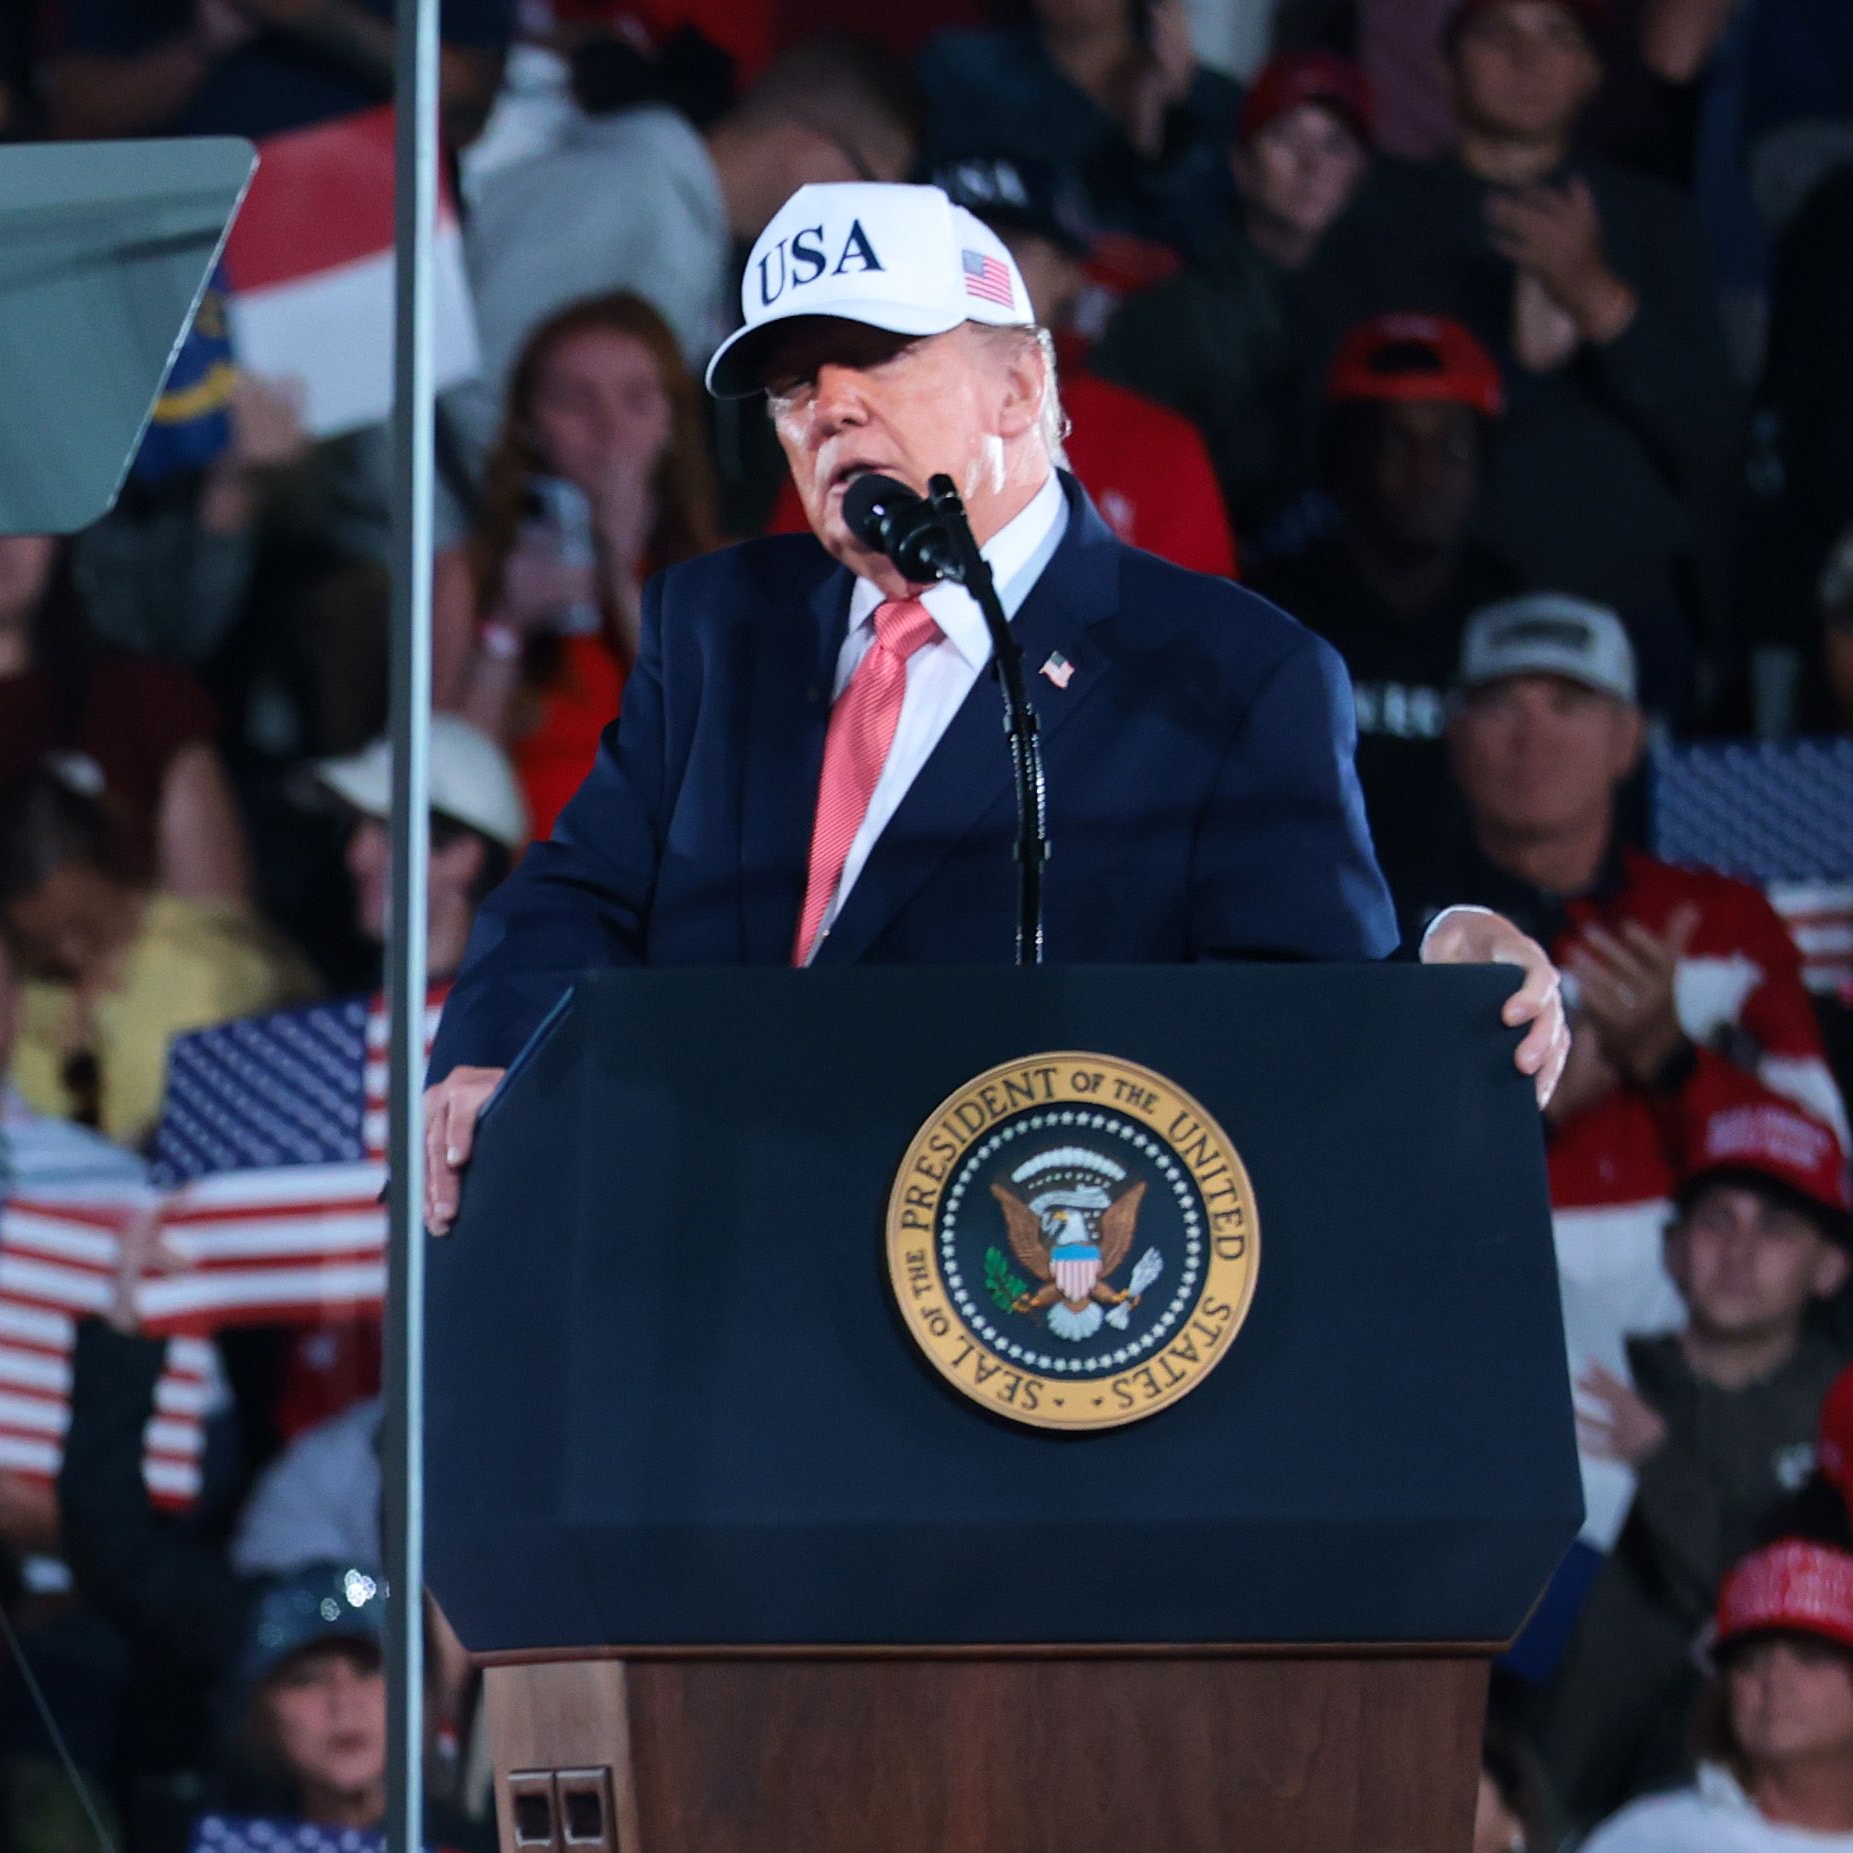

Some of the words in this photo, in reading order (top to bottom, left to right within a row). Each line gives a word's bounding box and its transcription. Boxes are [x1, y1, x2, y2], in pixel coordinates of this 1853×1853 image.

[758, 218, 886, 307] USA
[1071, 1071, 1101, 1094] OF
[1113, 1078, 1160, 1115] THE
[901, 1068, 1059, 1232] PRESIDENT
[1167, 1110, 1246, 1261] UNITED
[906, 1249, 934, 1297] THE
[920, 1302, 950, 1338] OF
[1111, 1296, 1231, 1409] STATES
[950, 1333, 1045, 1412] SEAL
